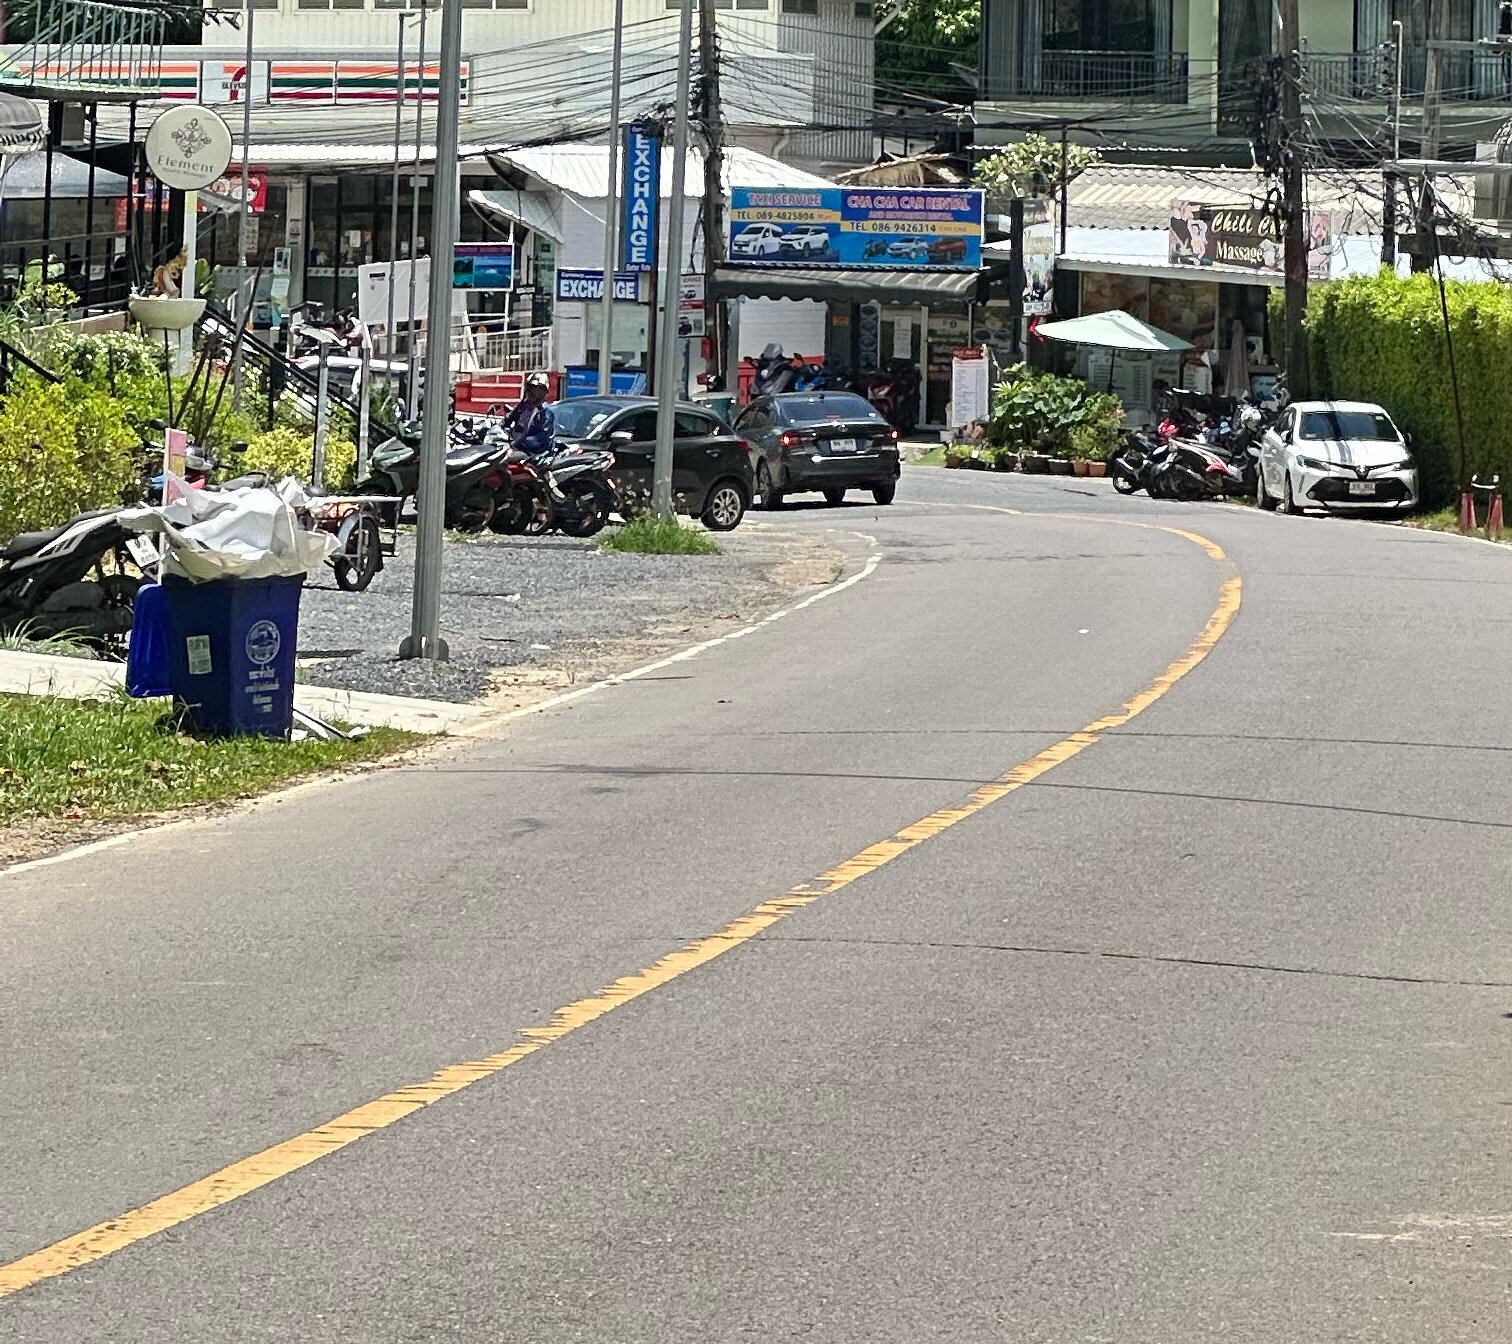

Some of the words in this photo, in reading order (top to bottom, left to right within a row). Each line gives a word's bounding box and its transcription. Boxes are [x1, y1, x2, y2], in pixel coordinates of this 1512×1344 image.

[157, 155, 214, 173] Element
[630, 133, 650, 263] EXCHANGE
[748, 193, 773, 205] TAXI
[775, 193, 822, 206] SERVICE
[847, 195, 873, 209] CHA
[873, 195, 899, 209] CHA
[900, 196, 925, 210] CAR
[926, 196, 971, 211] RENTAL
[1216, 239, 1263, 264] Massage
